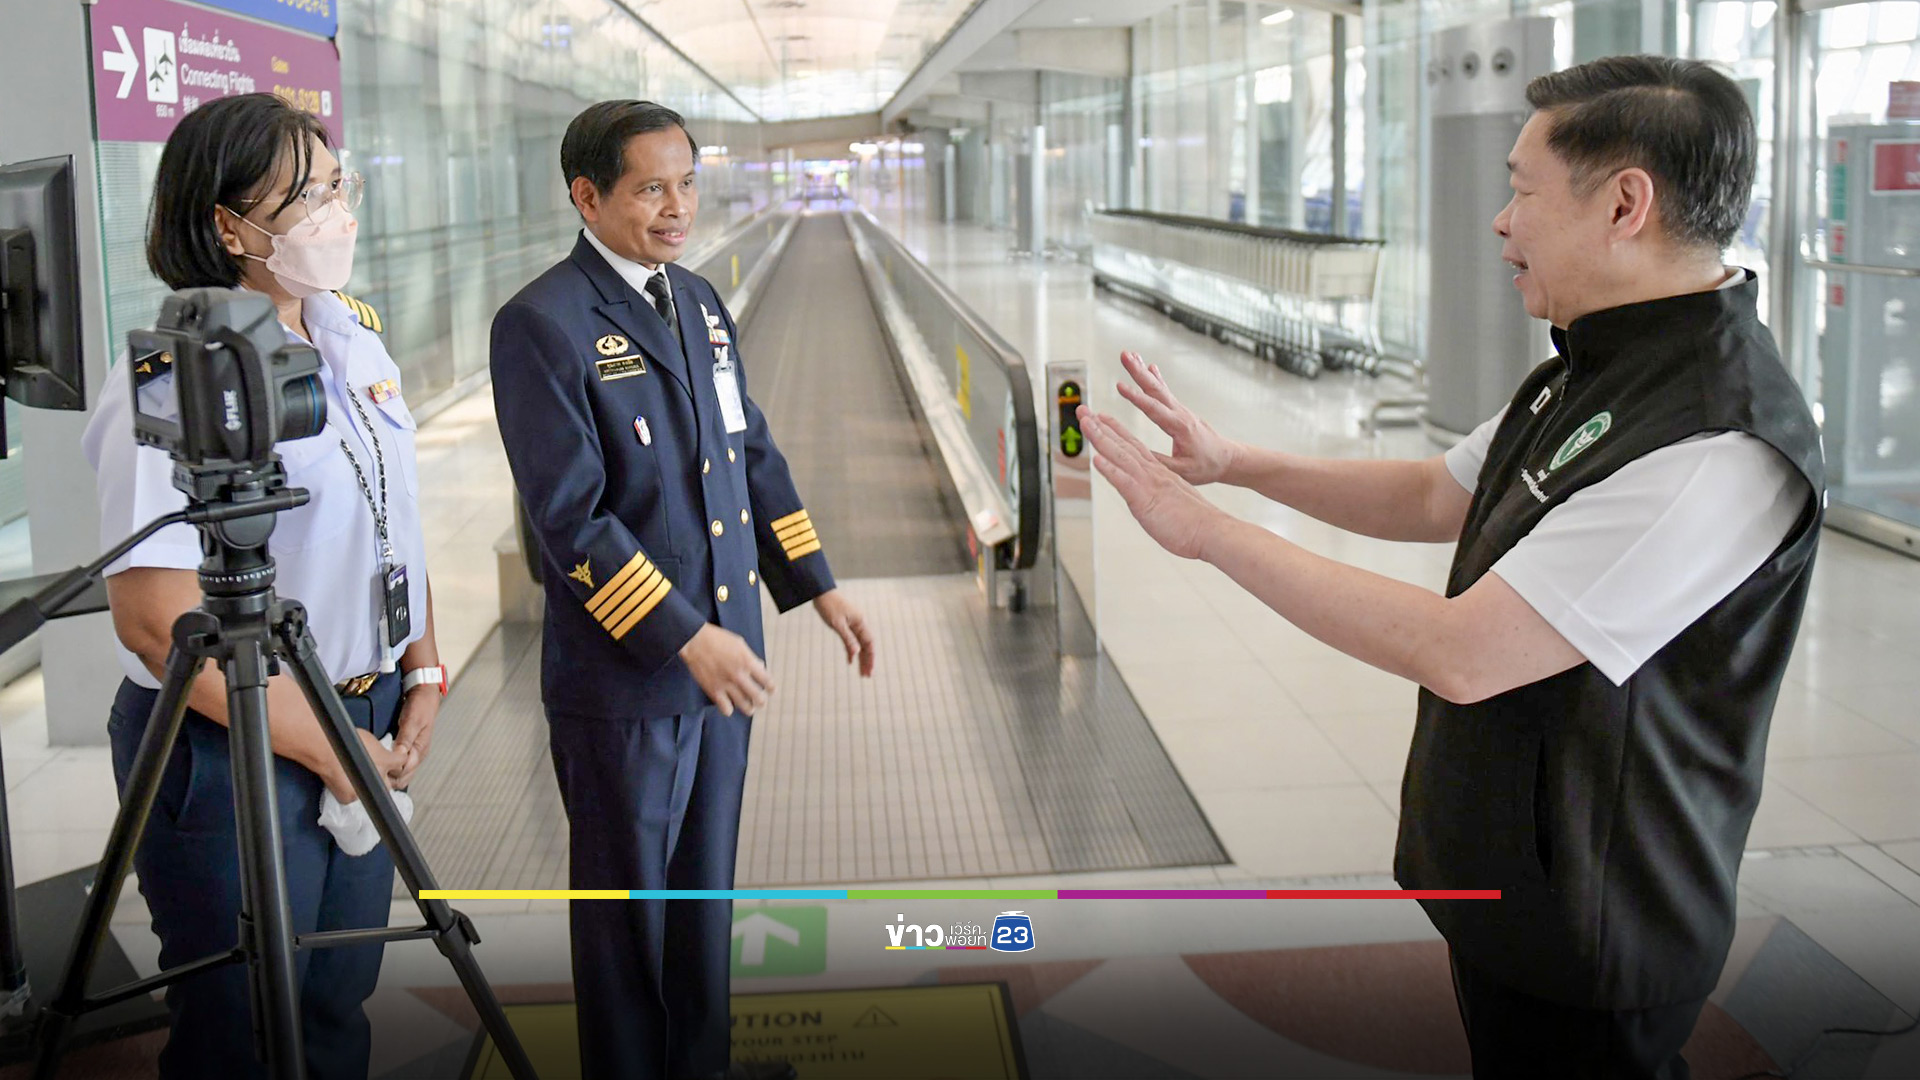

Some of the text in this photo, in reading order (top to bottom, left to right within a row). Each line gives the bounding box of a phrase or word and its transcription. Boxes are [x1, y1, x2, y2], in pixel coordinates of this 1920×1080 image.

[181, 63, 255, 96] Connecting Flights
[792, 1033, 838, 1046] STEP
